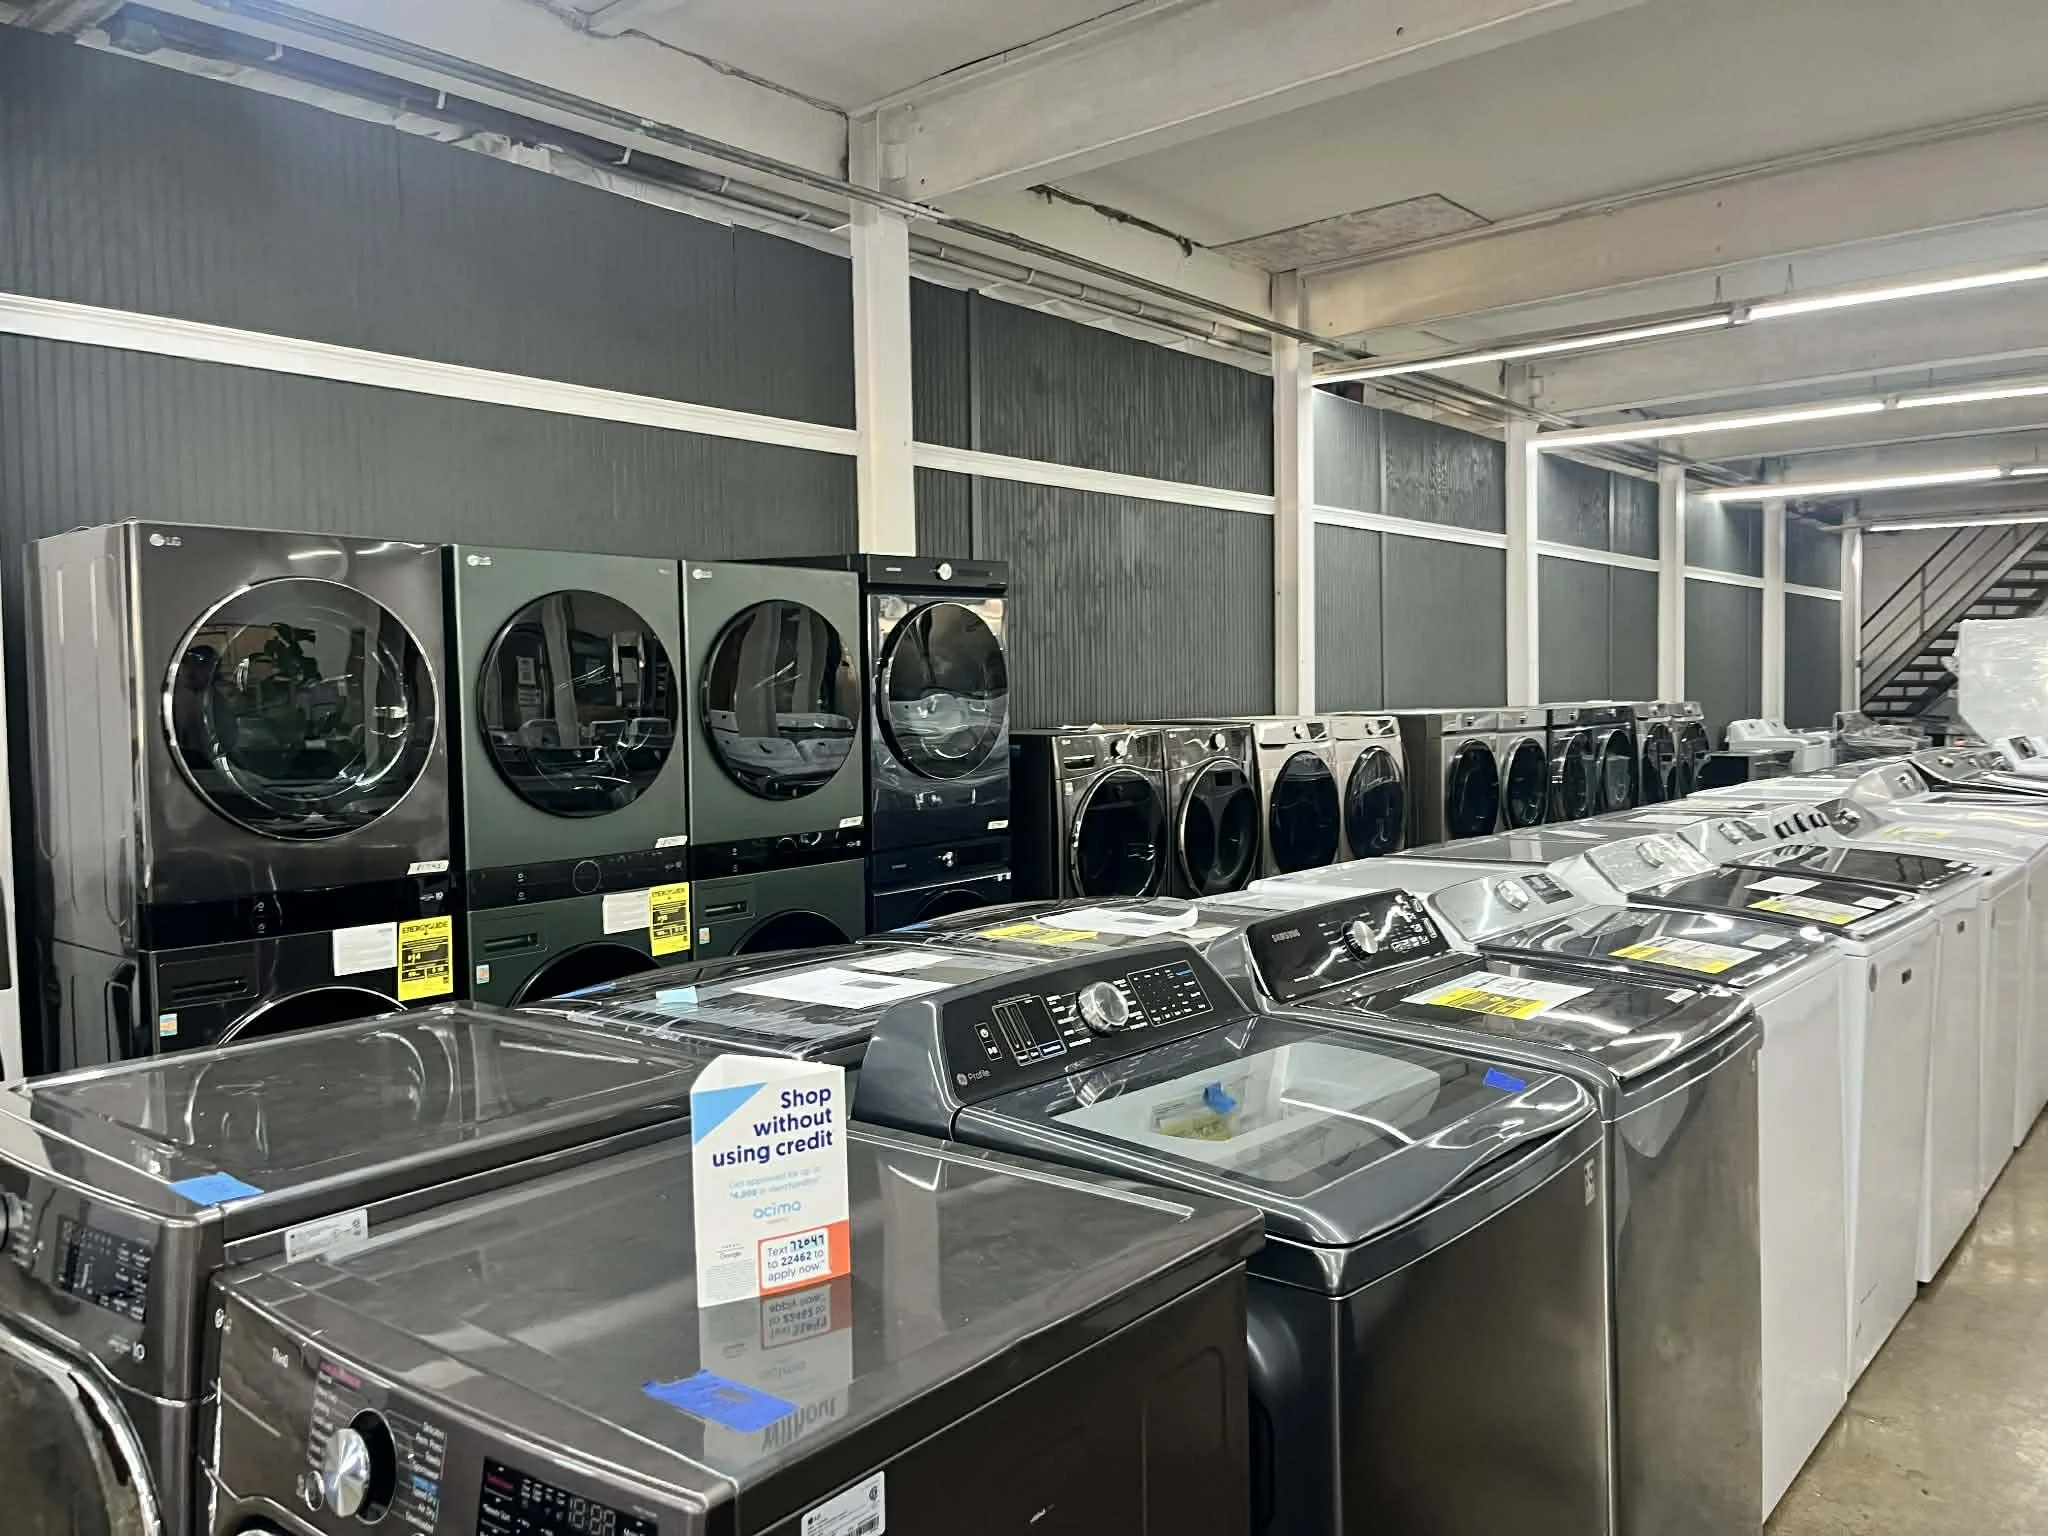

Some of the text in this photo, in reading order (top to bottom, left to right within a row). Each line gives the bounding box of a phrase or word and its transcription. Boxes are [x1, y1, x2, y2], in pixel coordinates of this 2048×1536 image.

[967, 1069, 991, 1081] Profile
[781, 1087, 832, 1109] Shop
[753, 1108, 833, 1137] without
[712, 1130, 833, 1167] using credit
[753, 1200, 802, 1219] acima
[768, 1234, 825, 1257] Text 72047
[767, 1248, 825, 1269] to 22462 to
[768, 1266, 796, 1282] apply
